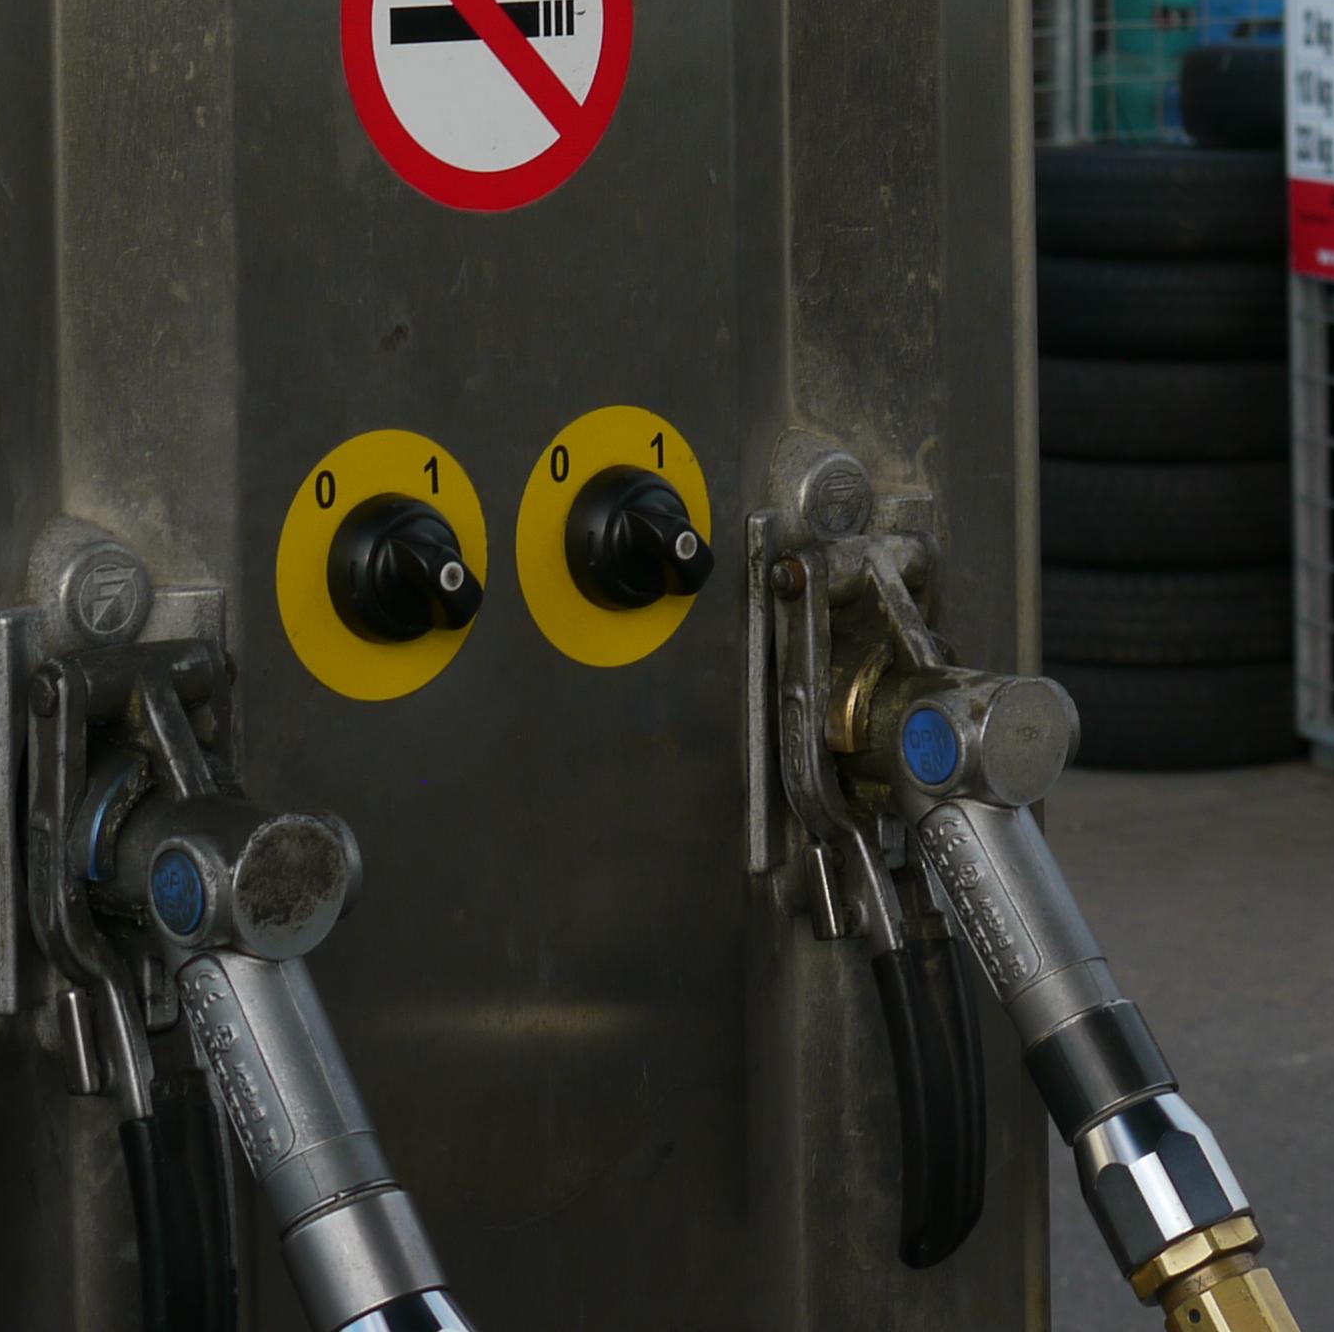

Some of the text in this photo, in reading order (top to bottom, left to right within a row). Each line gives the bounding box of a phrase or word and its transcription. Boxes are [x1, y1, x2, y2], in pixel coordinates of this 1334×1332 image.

[314, 456, 440, 509] 0 1
[550, 432, 665, 483] 0 1
